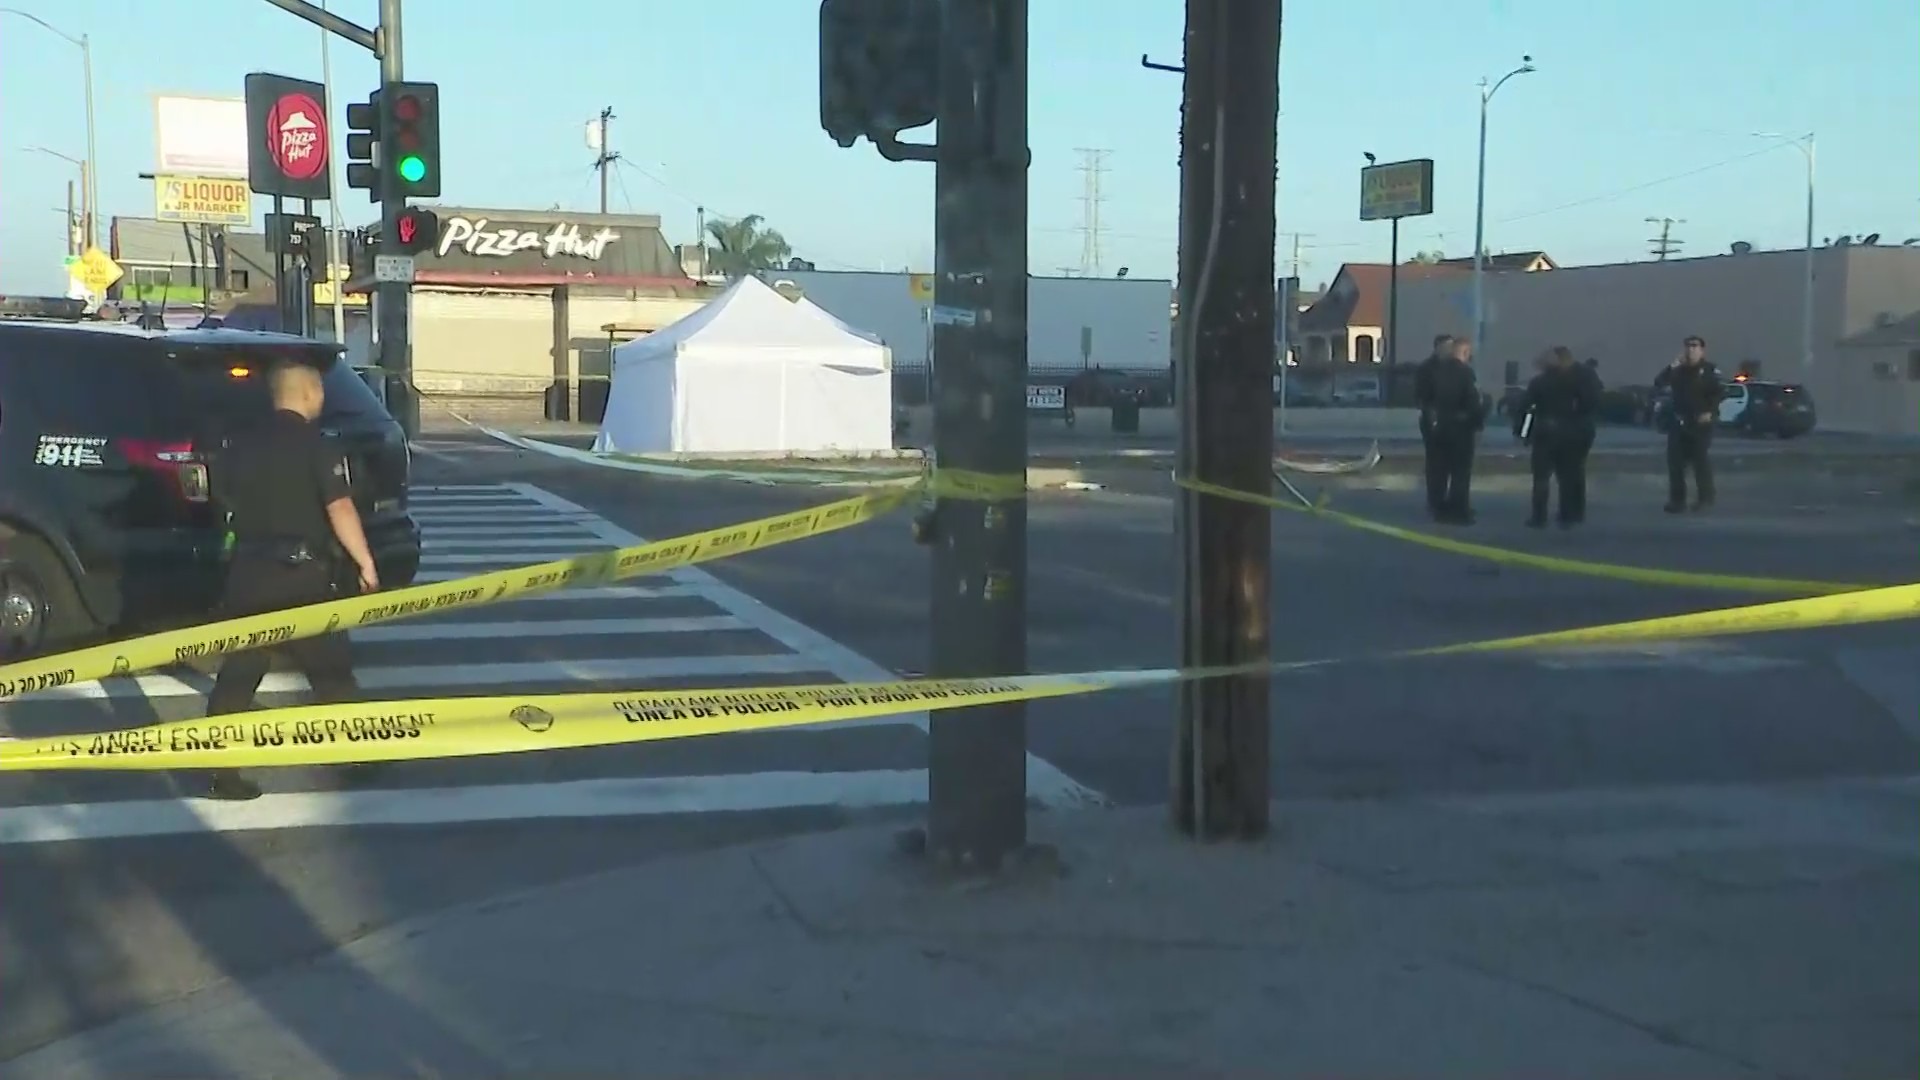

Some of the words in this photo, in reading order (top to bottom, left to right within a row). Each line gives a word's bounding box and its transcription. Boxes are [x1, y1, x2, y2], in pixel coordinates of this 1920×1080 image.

[281, 129, 317, 155] Pizza
[287, 143, 313, 163] Hut
[183, 183, 246, 202] LIQUOR
[174, 202, 190, 211] JR
[193, 202, 242, 213] MARKET
[438, 217, 541, 257] Pizza
[543, 222, 621, 259] Hut
[40, 435, 107, 446] EMERGENCY
[43, 443, 83, 466] 911
[623, 708, 689, 723] LINEA
[722, 700, 801, 717] POLICIA
[295, 712, 436, 737] DEPARTMENT
